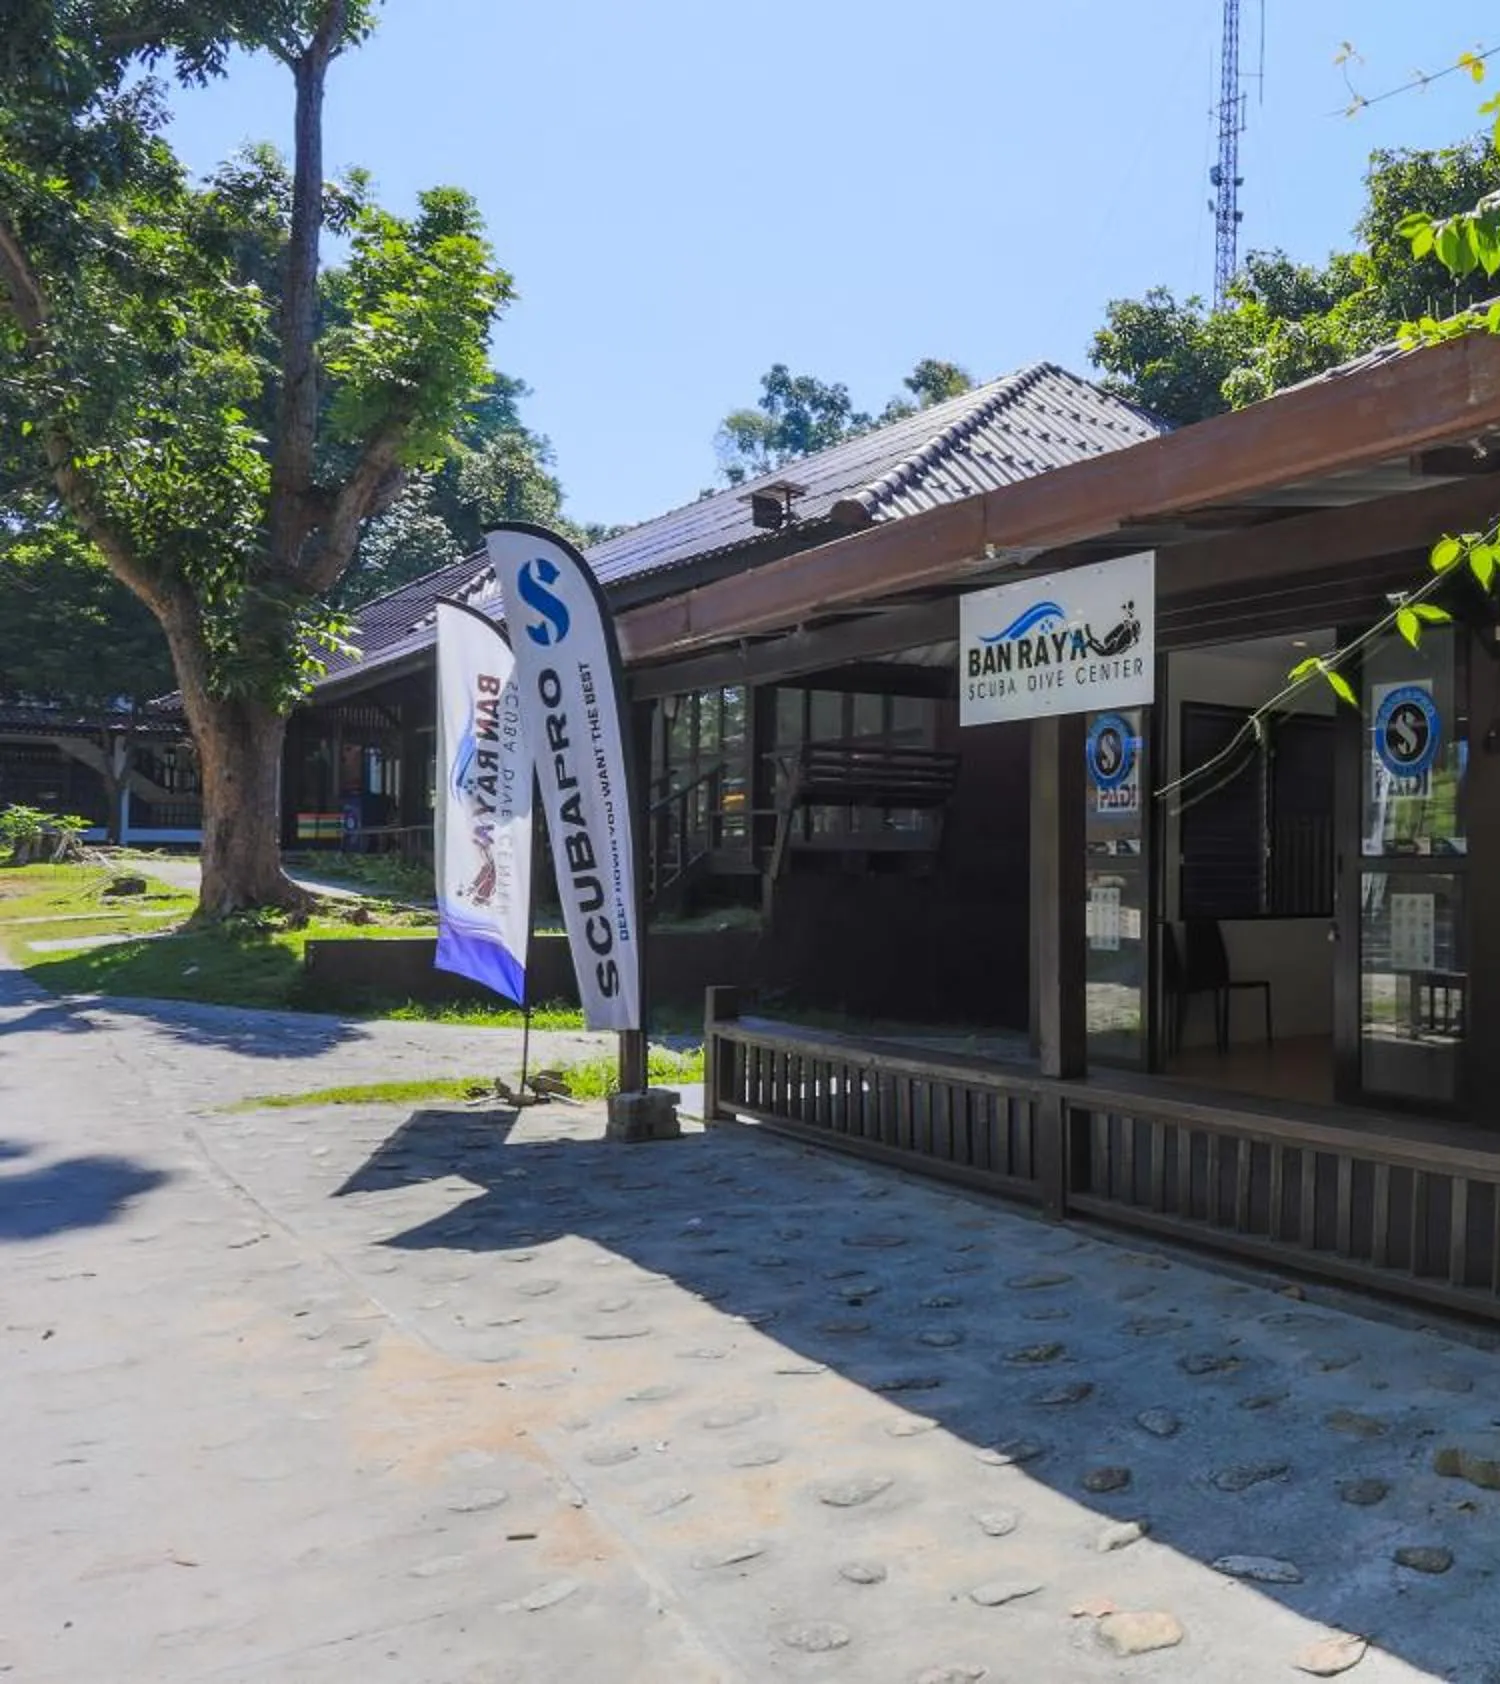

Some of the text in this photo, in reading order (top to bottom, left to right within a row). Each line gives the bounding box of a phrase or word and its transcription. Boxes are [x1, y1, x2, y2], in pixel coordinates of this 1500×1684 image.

[967, 627, 1088, 678] BAN RAYA
[577, 661, 597, 705] BEST
[967, 656, 1144, 701] SCUBA DIVE CENTER
[587, 709, 603, 742] THE
[594, 745, 612, 798] WANT
[537, 666, 621, 999] SCUBAPRO
